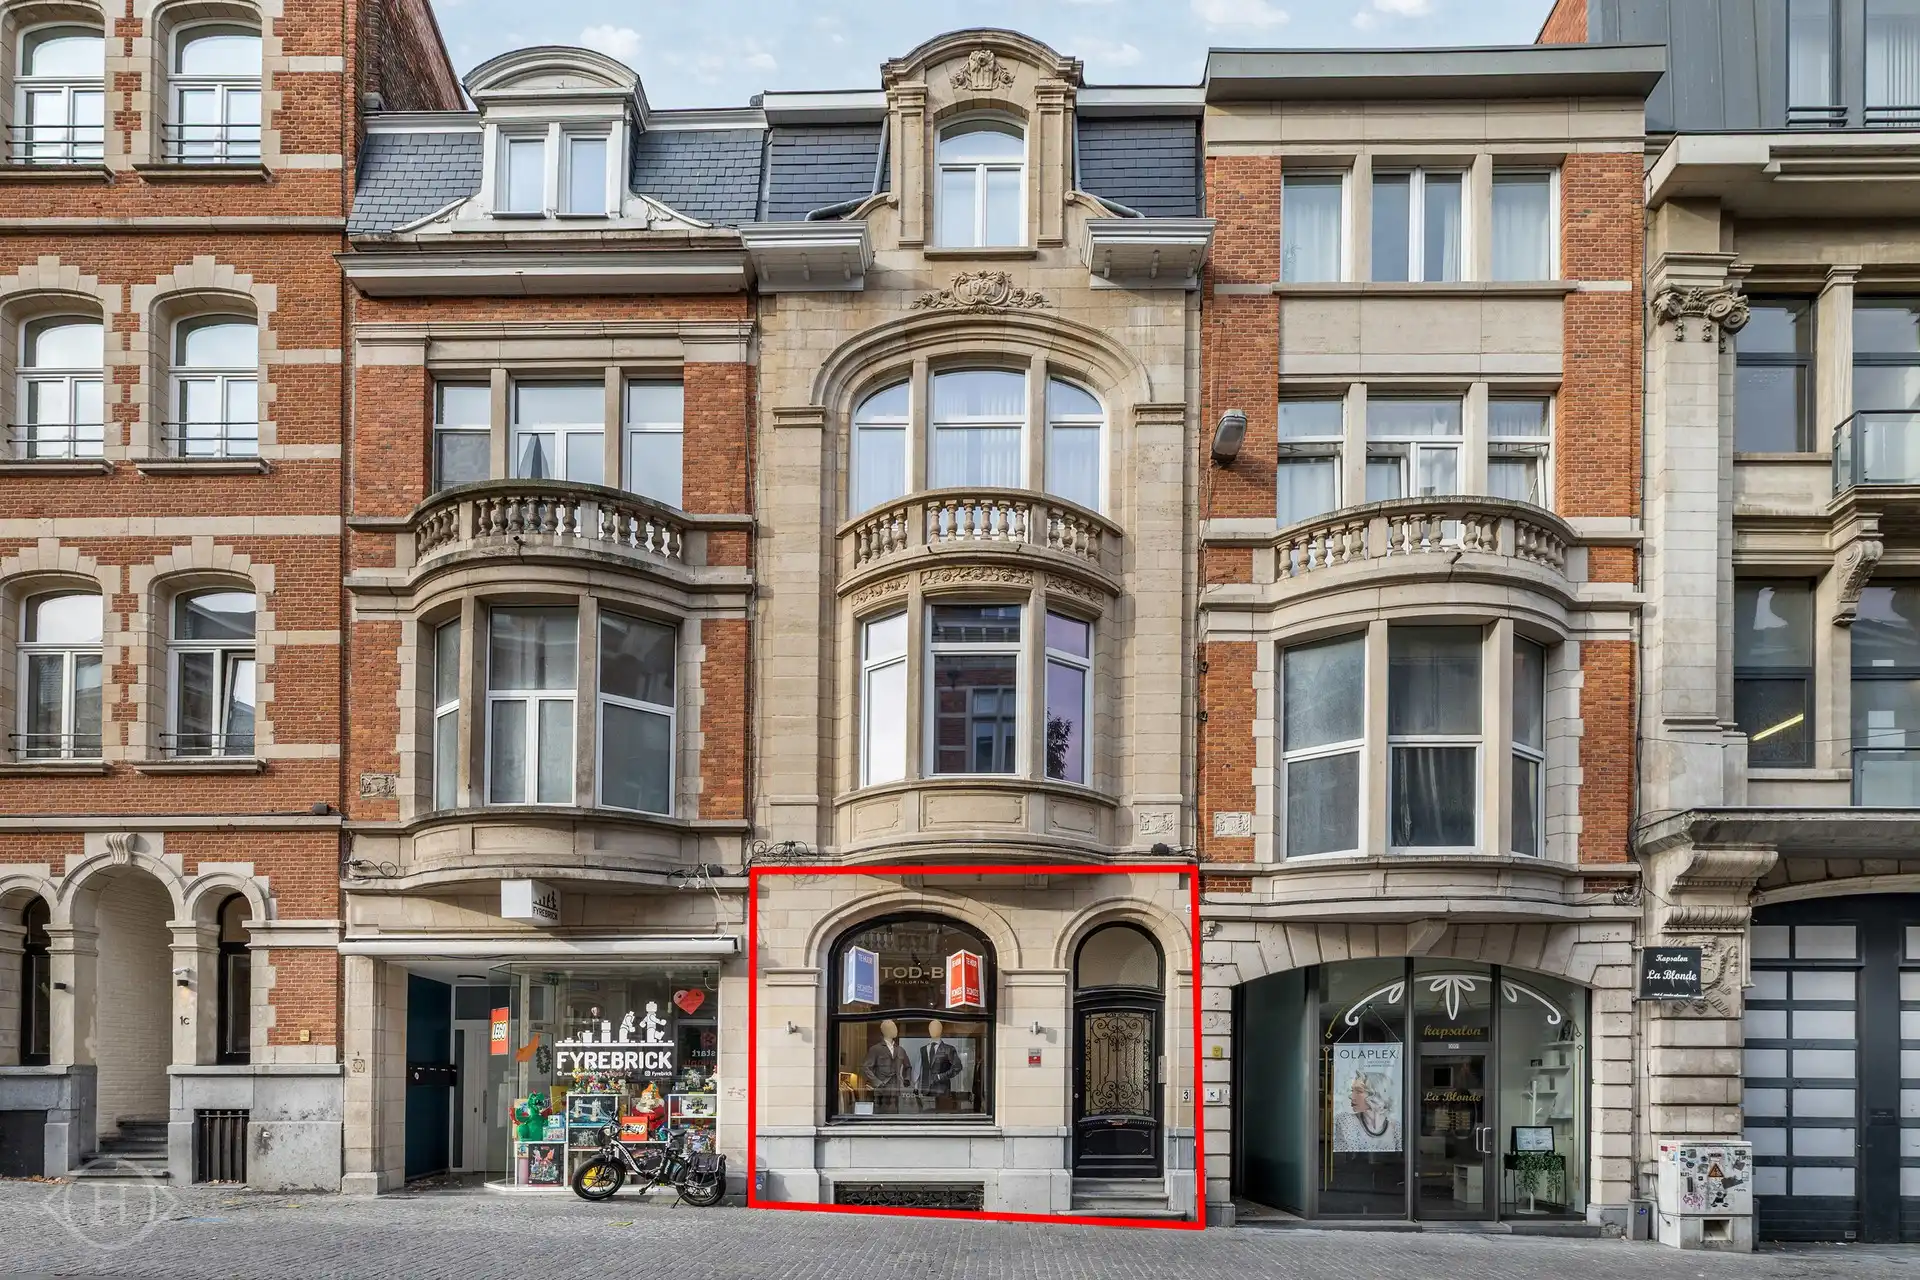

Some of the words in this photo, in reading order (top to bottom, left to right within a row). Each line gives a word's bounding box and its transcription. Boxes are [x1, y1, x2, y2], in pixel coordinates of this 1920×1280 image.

[967, 280, 997, 297] 1921
[533, 906, 559, 920] FYREBRICK
[1655, 954, 1688, 963] Kapsalon
[880, 966, 944, 979] TOD-B
[1646, 969, 1661, 980] La
[1663, 969, 1697, 981] Blonde
[492, 1021, 507, 1041] LEGO
[1424, 1025, 1481, 1039] kapsalon
[556, 1051, 673, 1069] FYREBRICK
[1183, 1090, 1189, 1100] 3
[1424, 1091, 1440, 1102] La
[1442, 1091, 1482, 1102] Blonde
